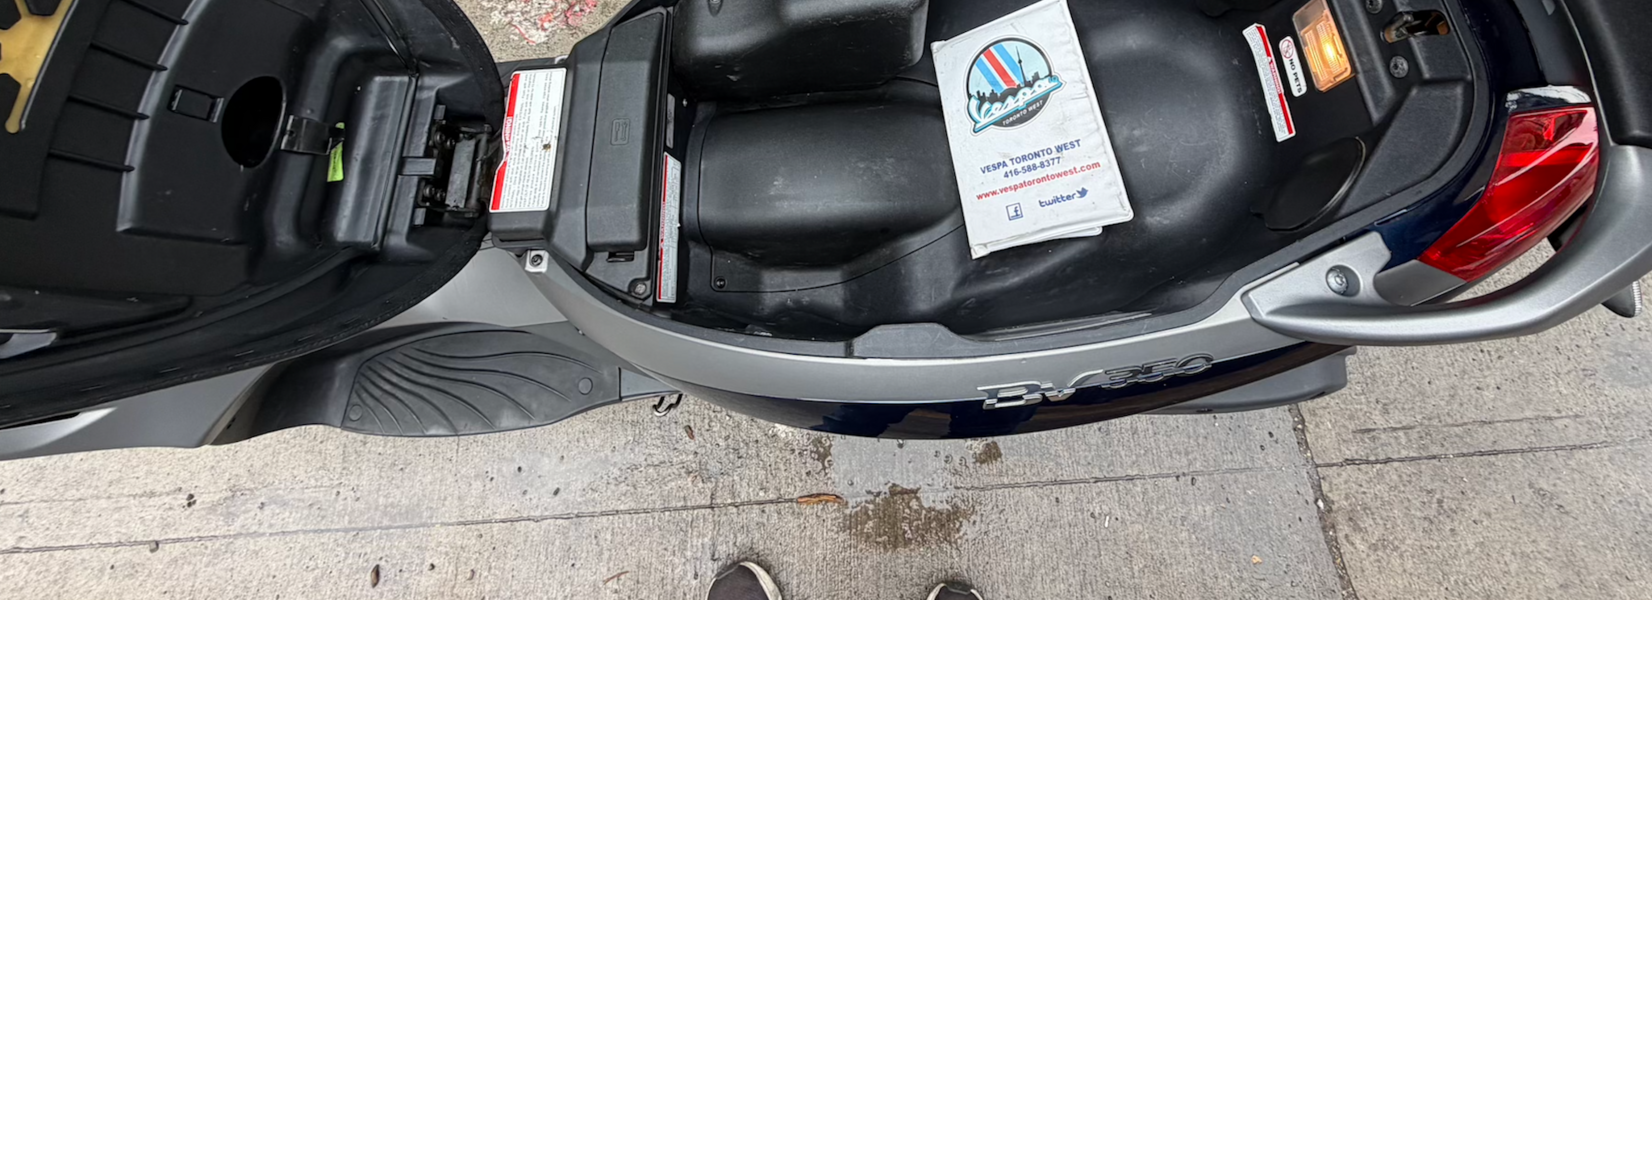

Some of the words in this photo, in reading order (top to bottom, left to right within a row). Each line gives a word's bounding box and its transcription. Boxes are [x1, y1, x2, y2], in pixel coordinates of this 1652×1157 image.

[1289, 58, 1296, 71] NO
[1292, 72, 1302, 94] PETS
[968, 76, 1062, 133] Vespa
[1002, 109, 1027, 126] TORONTO
[1028, 100, 1043, 113] WEST
[980, 160, 1008, 174] VESPA
[1009, 147, 1053, 166] TORONTO
[1054, 139, 1081, 153] WEST
[1003, 156, 1061, 179] 416-588-8377
[976, 161, 1101, 200] www.vespatorontowest.com
[1038, 192, 1077, 208] twitter
